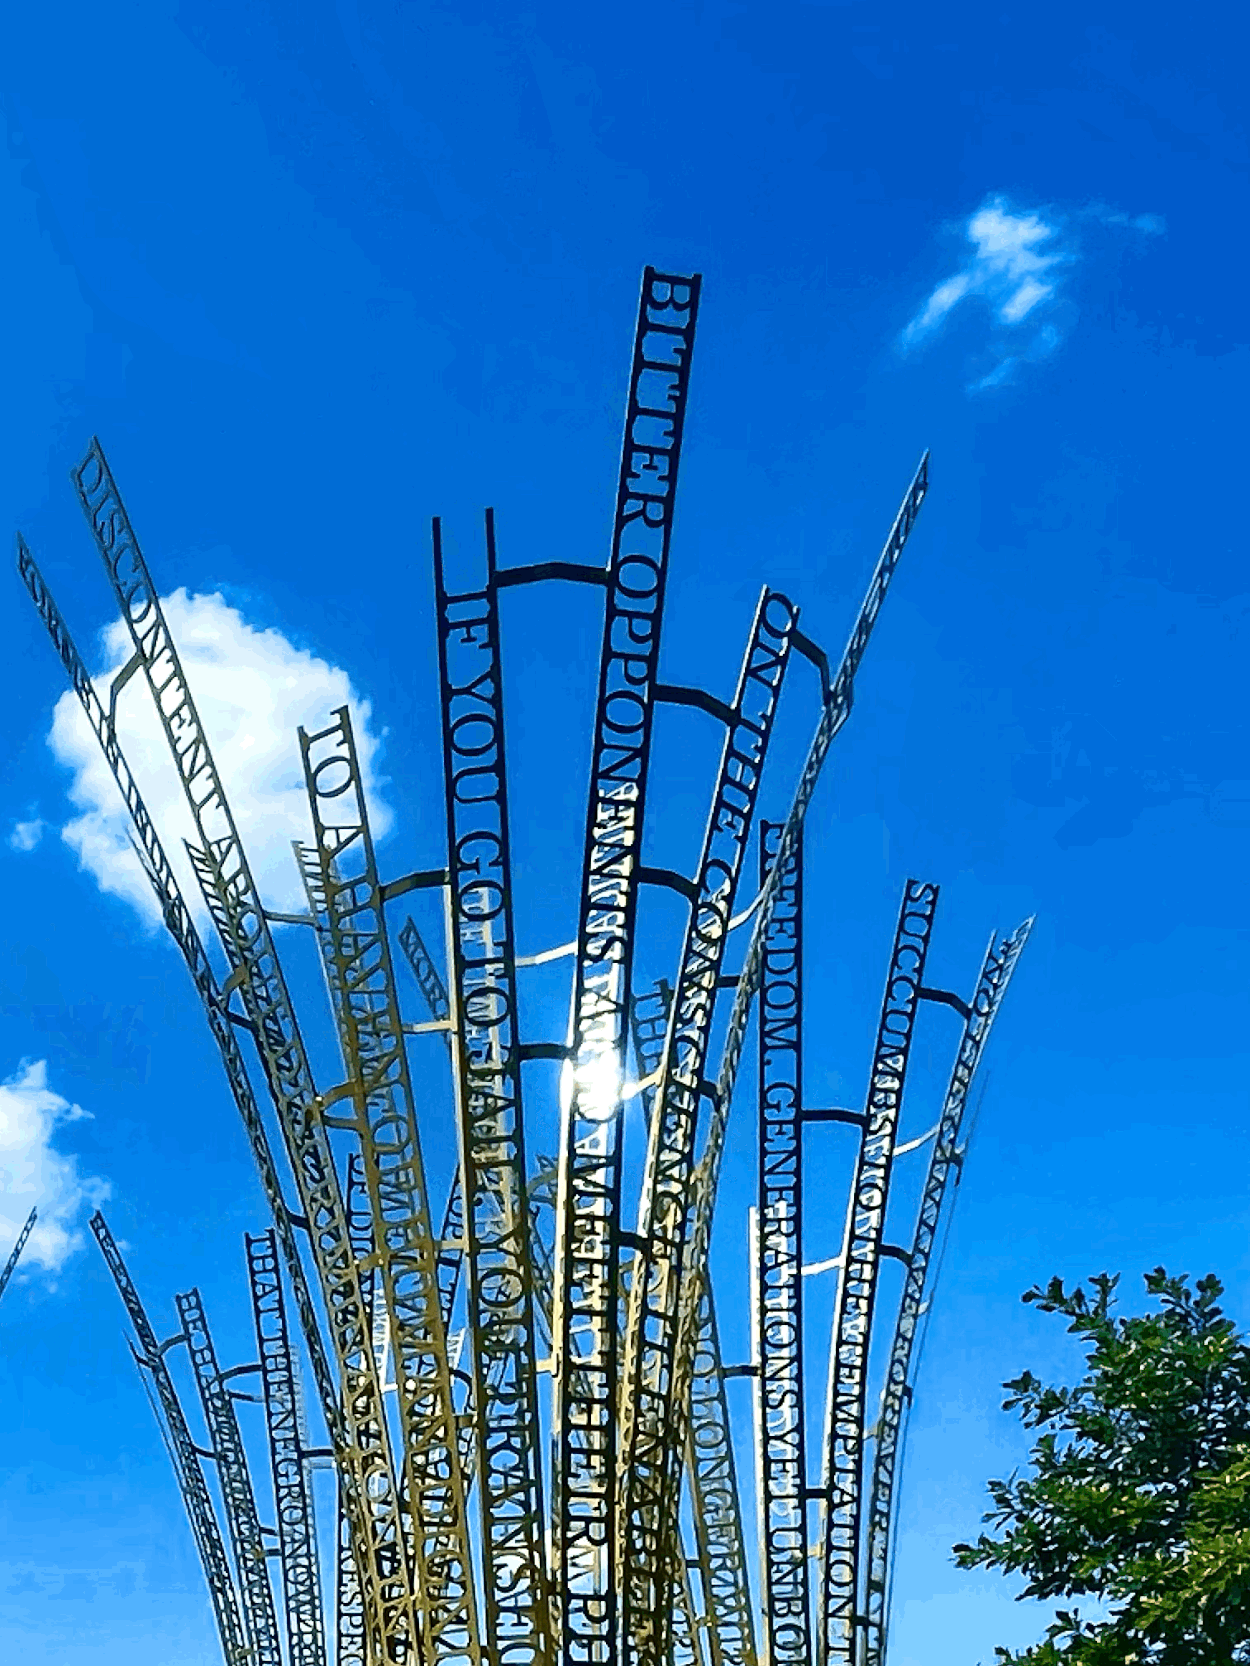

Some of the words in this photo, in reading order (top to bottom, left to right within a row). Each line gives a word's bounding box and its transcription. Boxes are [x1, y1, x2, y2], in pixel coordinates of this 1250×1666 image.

[620, 270, 699, 530] BITTER
[71, 447, 229, 820] DISCONTENT
[442, 586, 497, 652] IF
[744, 587, 800, 686] ON
[295, 700, 360, 805] TO
[446, 666, 506, 804] YOU
[706, 690, 774, 849] THE
[317, 818, 370, 863] A
[456, 828, 511, 924] GO
[868, 876, 939, 1138] SUCCUMBS
[248, 1230, 285, 1324] THAT
[762, 1079, 804, 1416] GENERATIONS
[258, 1326, 292, 1396] THE
[268, 1401, 309, 1530] NEGRO
